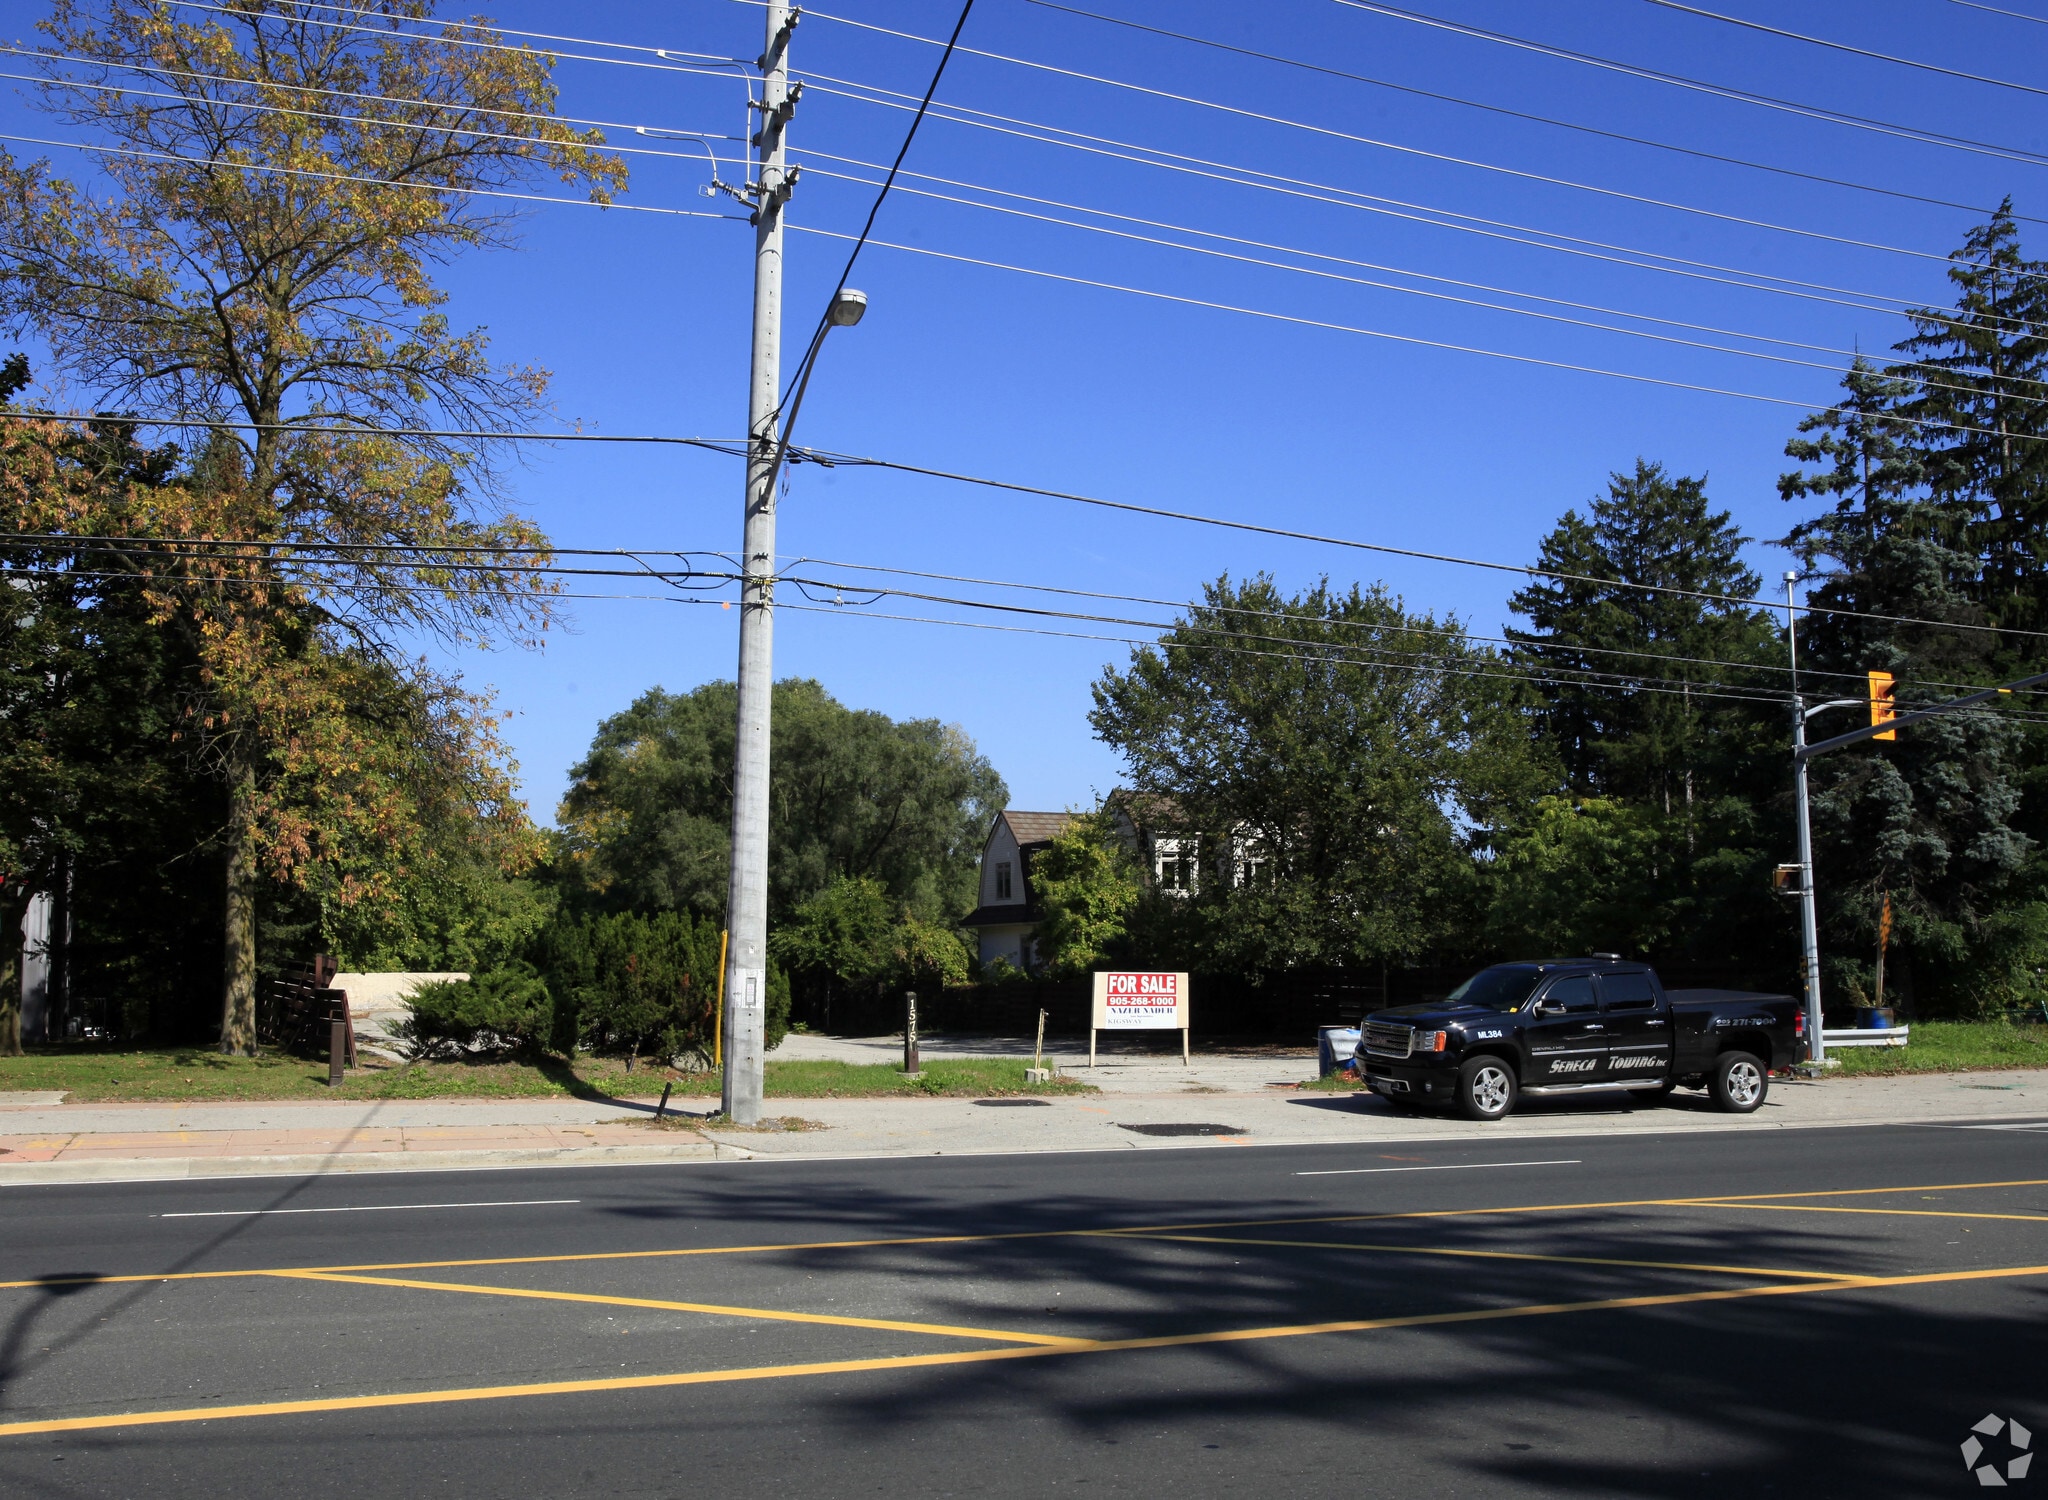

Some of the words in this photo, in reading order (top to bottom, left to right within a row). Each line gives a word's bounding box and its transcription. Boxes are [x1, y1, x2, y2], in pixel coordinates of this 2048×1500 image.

[1109, 976, 1137, 993] FOR
[1140, 976, 1175, 993] SALE
[1110, 997, 1174, 1005] 905-268-1000
[908, 998, 917, 1042] 1575
[1477, 1030, 1502, 1039] ML384
